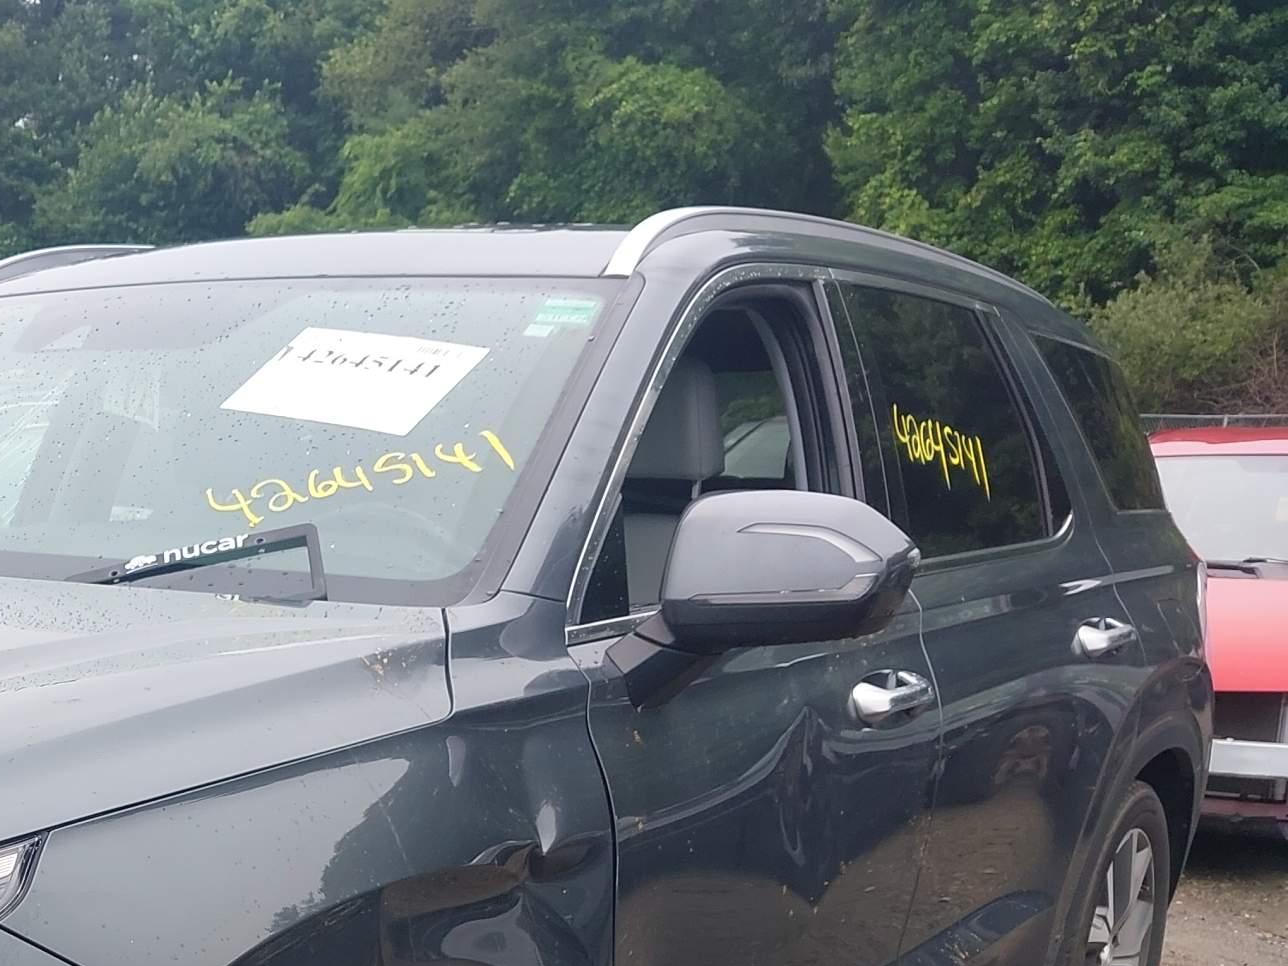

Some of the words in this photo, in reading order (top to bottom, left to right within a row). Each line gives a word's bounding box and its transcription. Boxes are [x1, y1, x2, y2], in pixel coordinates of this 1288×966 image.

[205, 430, 515, 527] 42645141
[893, 403, 991, 503] 42645141
[163, 533, 249, 564] nucar
